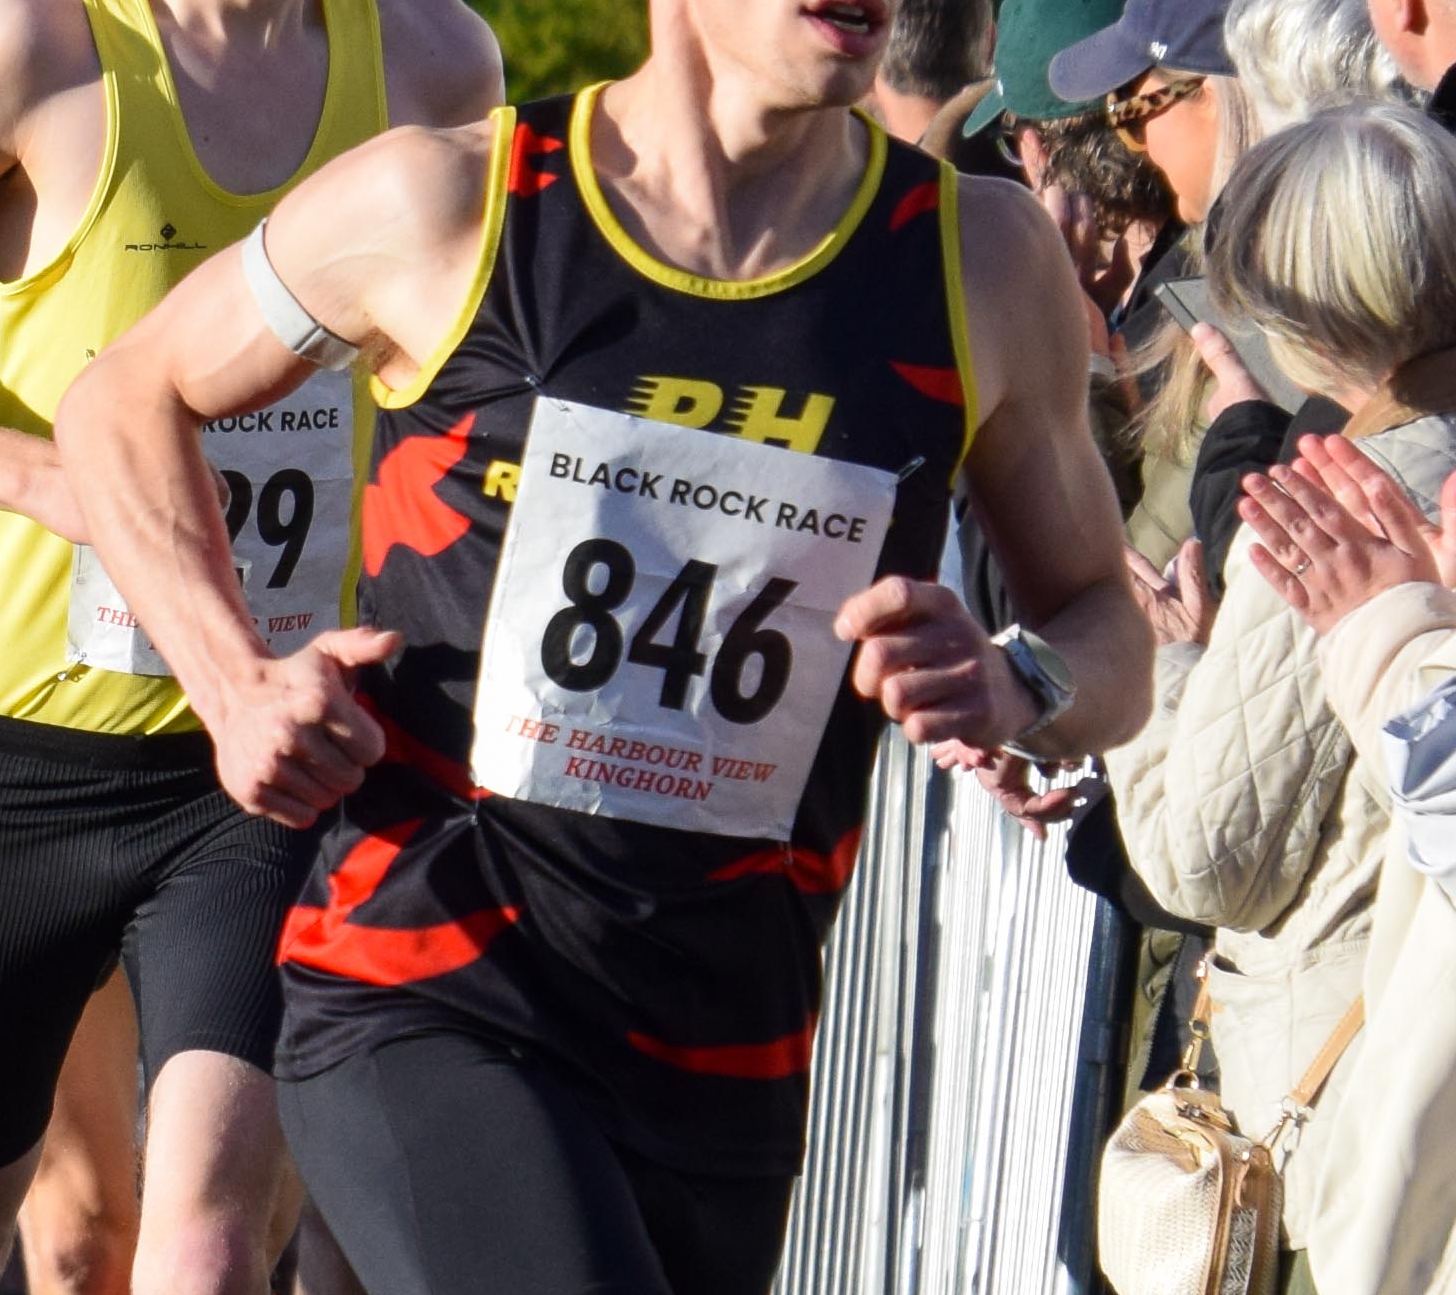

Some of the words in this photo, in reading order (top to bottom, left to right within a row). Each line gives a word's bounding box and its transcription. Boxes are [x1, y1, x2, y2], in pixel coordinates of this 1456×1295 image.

[280, 408, 340, 432] RACE
[549, 452, 663, 500] BLACK
[670, 478, 770, 524] ROCK
[775, 502, 868, 543] RACE
[268, 612, 314, 633] VIEW
[540, 537, 798, 725] 846
[505, 715, 560, 744] THE
[566, 728, 703, 772] HARBOUR
[709, 756, 778, 783] VIEW
[564, 756, 715, 801] KINGHORN
